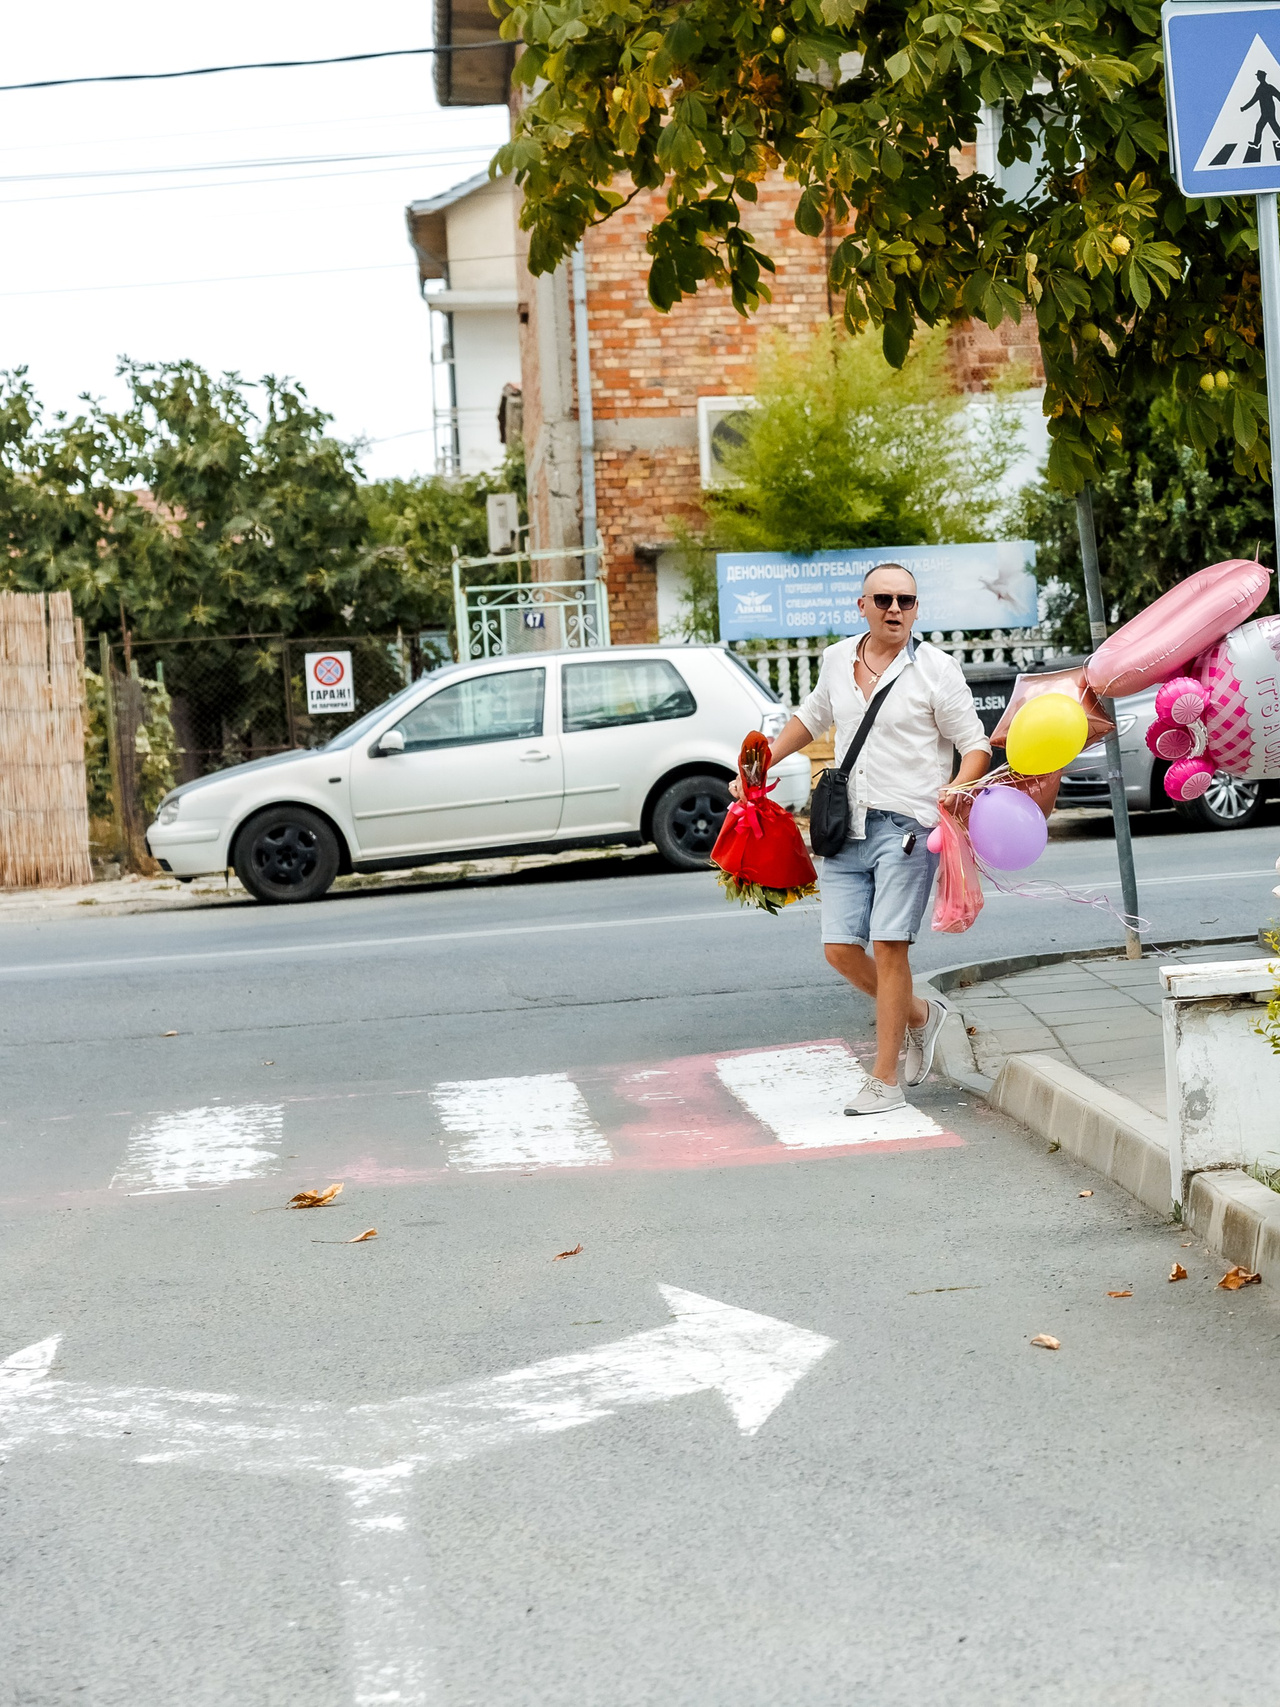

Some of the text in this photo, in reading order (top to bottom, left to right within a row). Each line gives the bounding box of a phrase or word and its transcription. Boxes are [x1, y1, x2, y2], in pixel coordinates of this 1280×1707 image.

[726, 564, 800, 583] ДЕНОНОЩНО
[786, 611, 817, 627] 0889
[819, 610, 841, 625] 215
